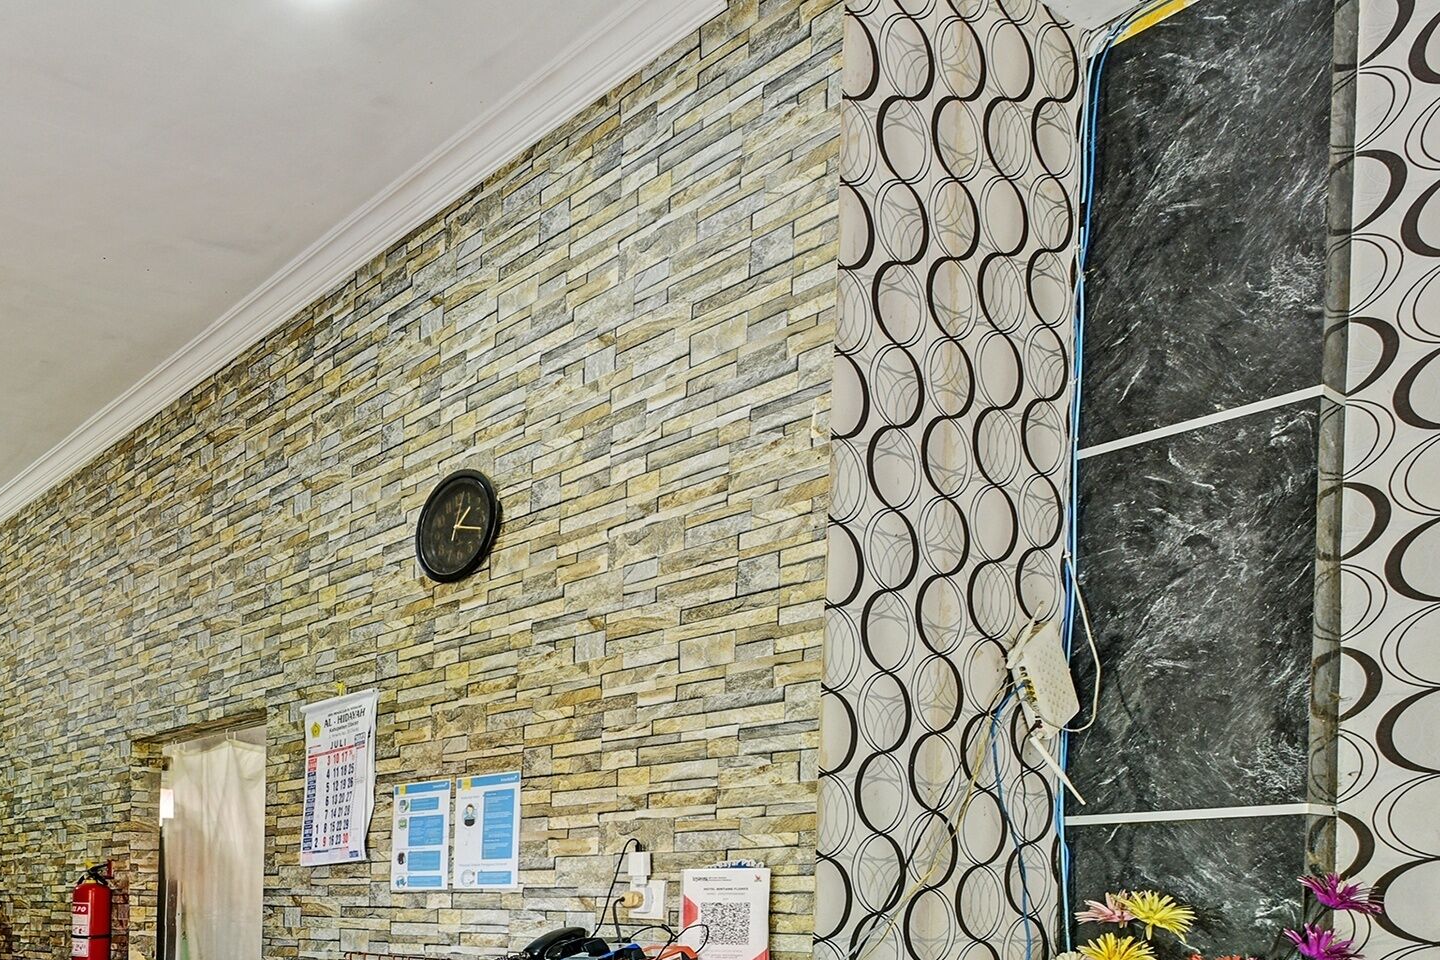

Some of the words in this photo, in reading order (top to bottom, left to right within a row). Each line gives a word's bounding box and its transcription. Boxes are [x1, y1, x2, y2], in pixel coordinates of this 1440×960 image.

[324, 718, 332, 728] AL
[330, 739, 346, 749] JULI
[333, 754, 339, 764] 10
[342, 752, 348, 762] 17
[333, 767, 339, 778] 11
[341, 765, 347, 776] 18
[348, 763, 354, 774] 25
[333, 781, 338, 791] 12
[340, 779, 346, 789] 19
[348, 777, 354, 788] 26
[332, 795, 338, 805] 13
[339, 793, 345, 803] 20
[346, 791, 352, 802] 27
[331, 808, 336, 818] 14
[338, 806, 343, 817] 21
[344, 805, 350, 816] 28
[330, 821, 335, 832] 15
[336, 820, 342, 831] 22
[343, 819, 349, 830] 29
[329, 835, 334, 846] 16
[335, 834, 341, 845] 23
[343, 833, 348, 844] 30
